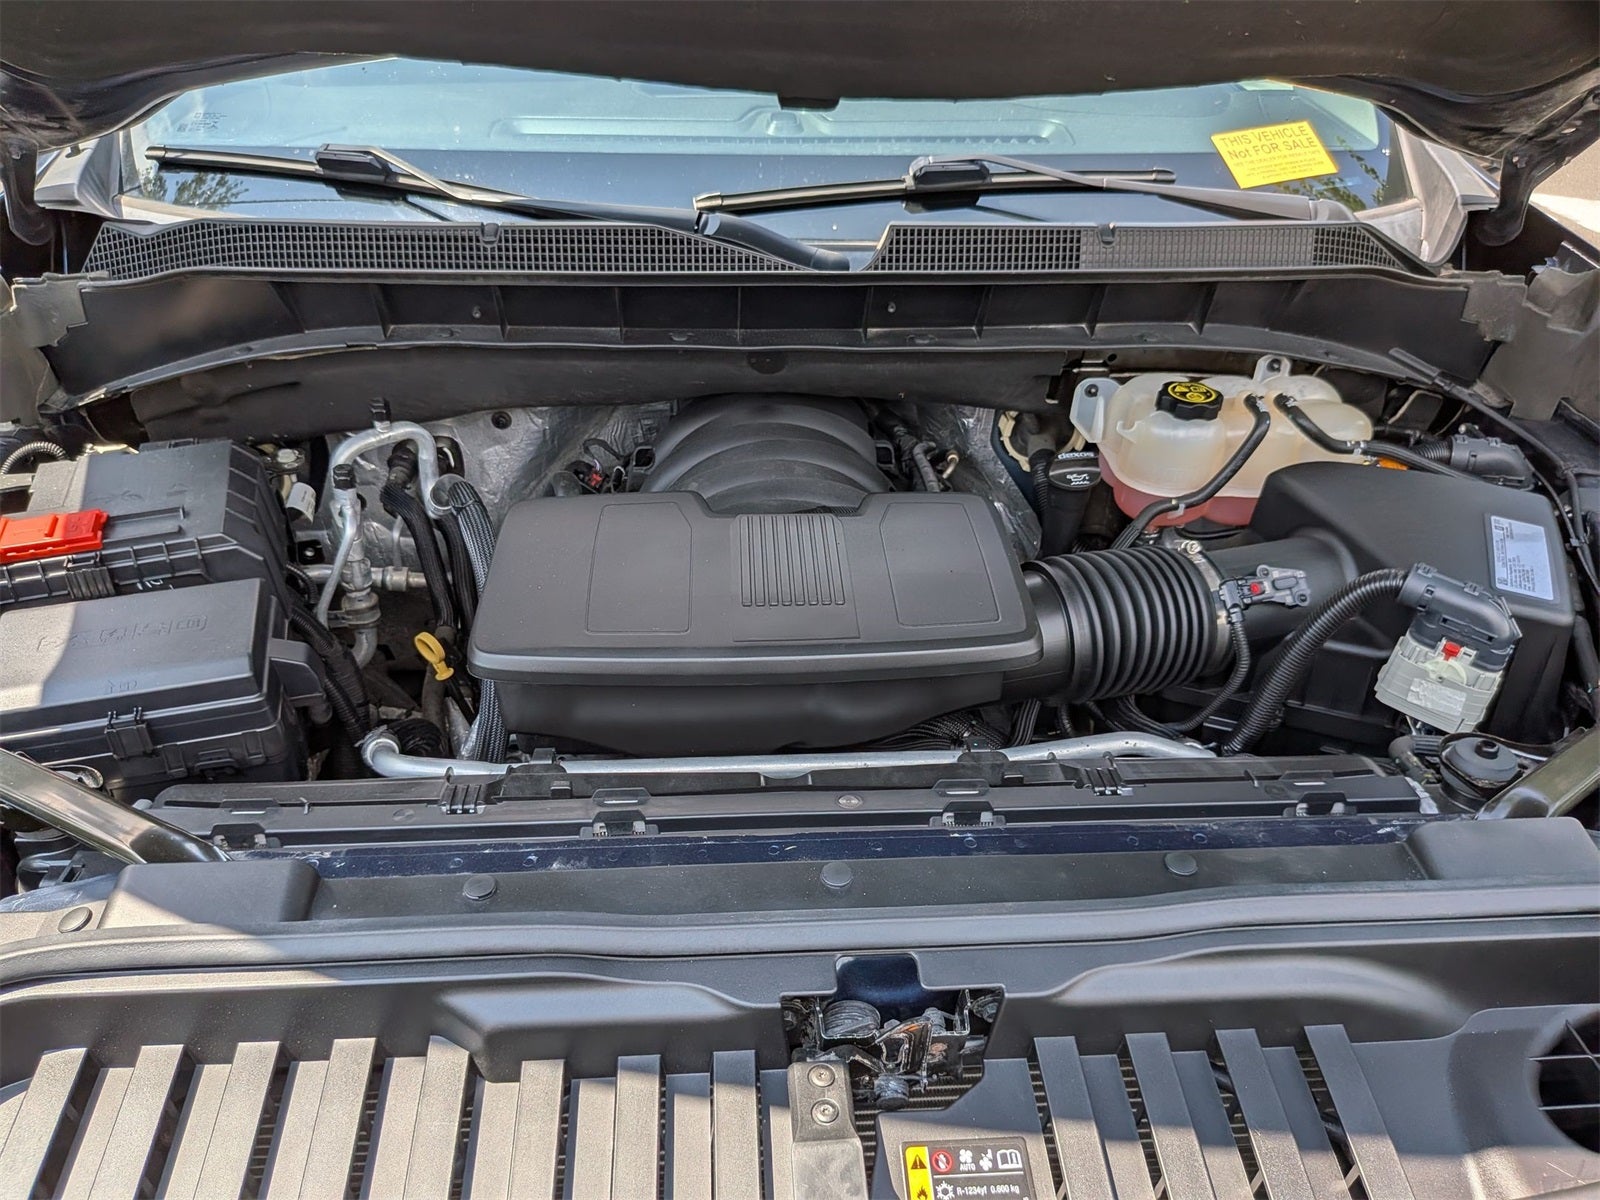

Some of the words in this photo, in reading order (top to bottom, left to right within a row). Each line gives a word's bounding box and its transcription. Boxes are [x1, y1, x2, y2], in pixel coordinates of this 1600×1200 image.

[1219, 134, 1251, 147] THIS
[1251, 125, 1308, 142] VEHICLE
[1227, 148, 1251, 160] Not
[1252, 142, 1282, 156] FOR
[1285, 137, 1317, 151] SALE
[1057, 451, 1095, 459] dexos
[959, 1163, 976, 1172] AUTO
[956, 1185, 987, 1197] R-1234yf
[1010, 1184, 1020, 1195] kg
